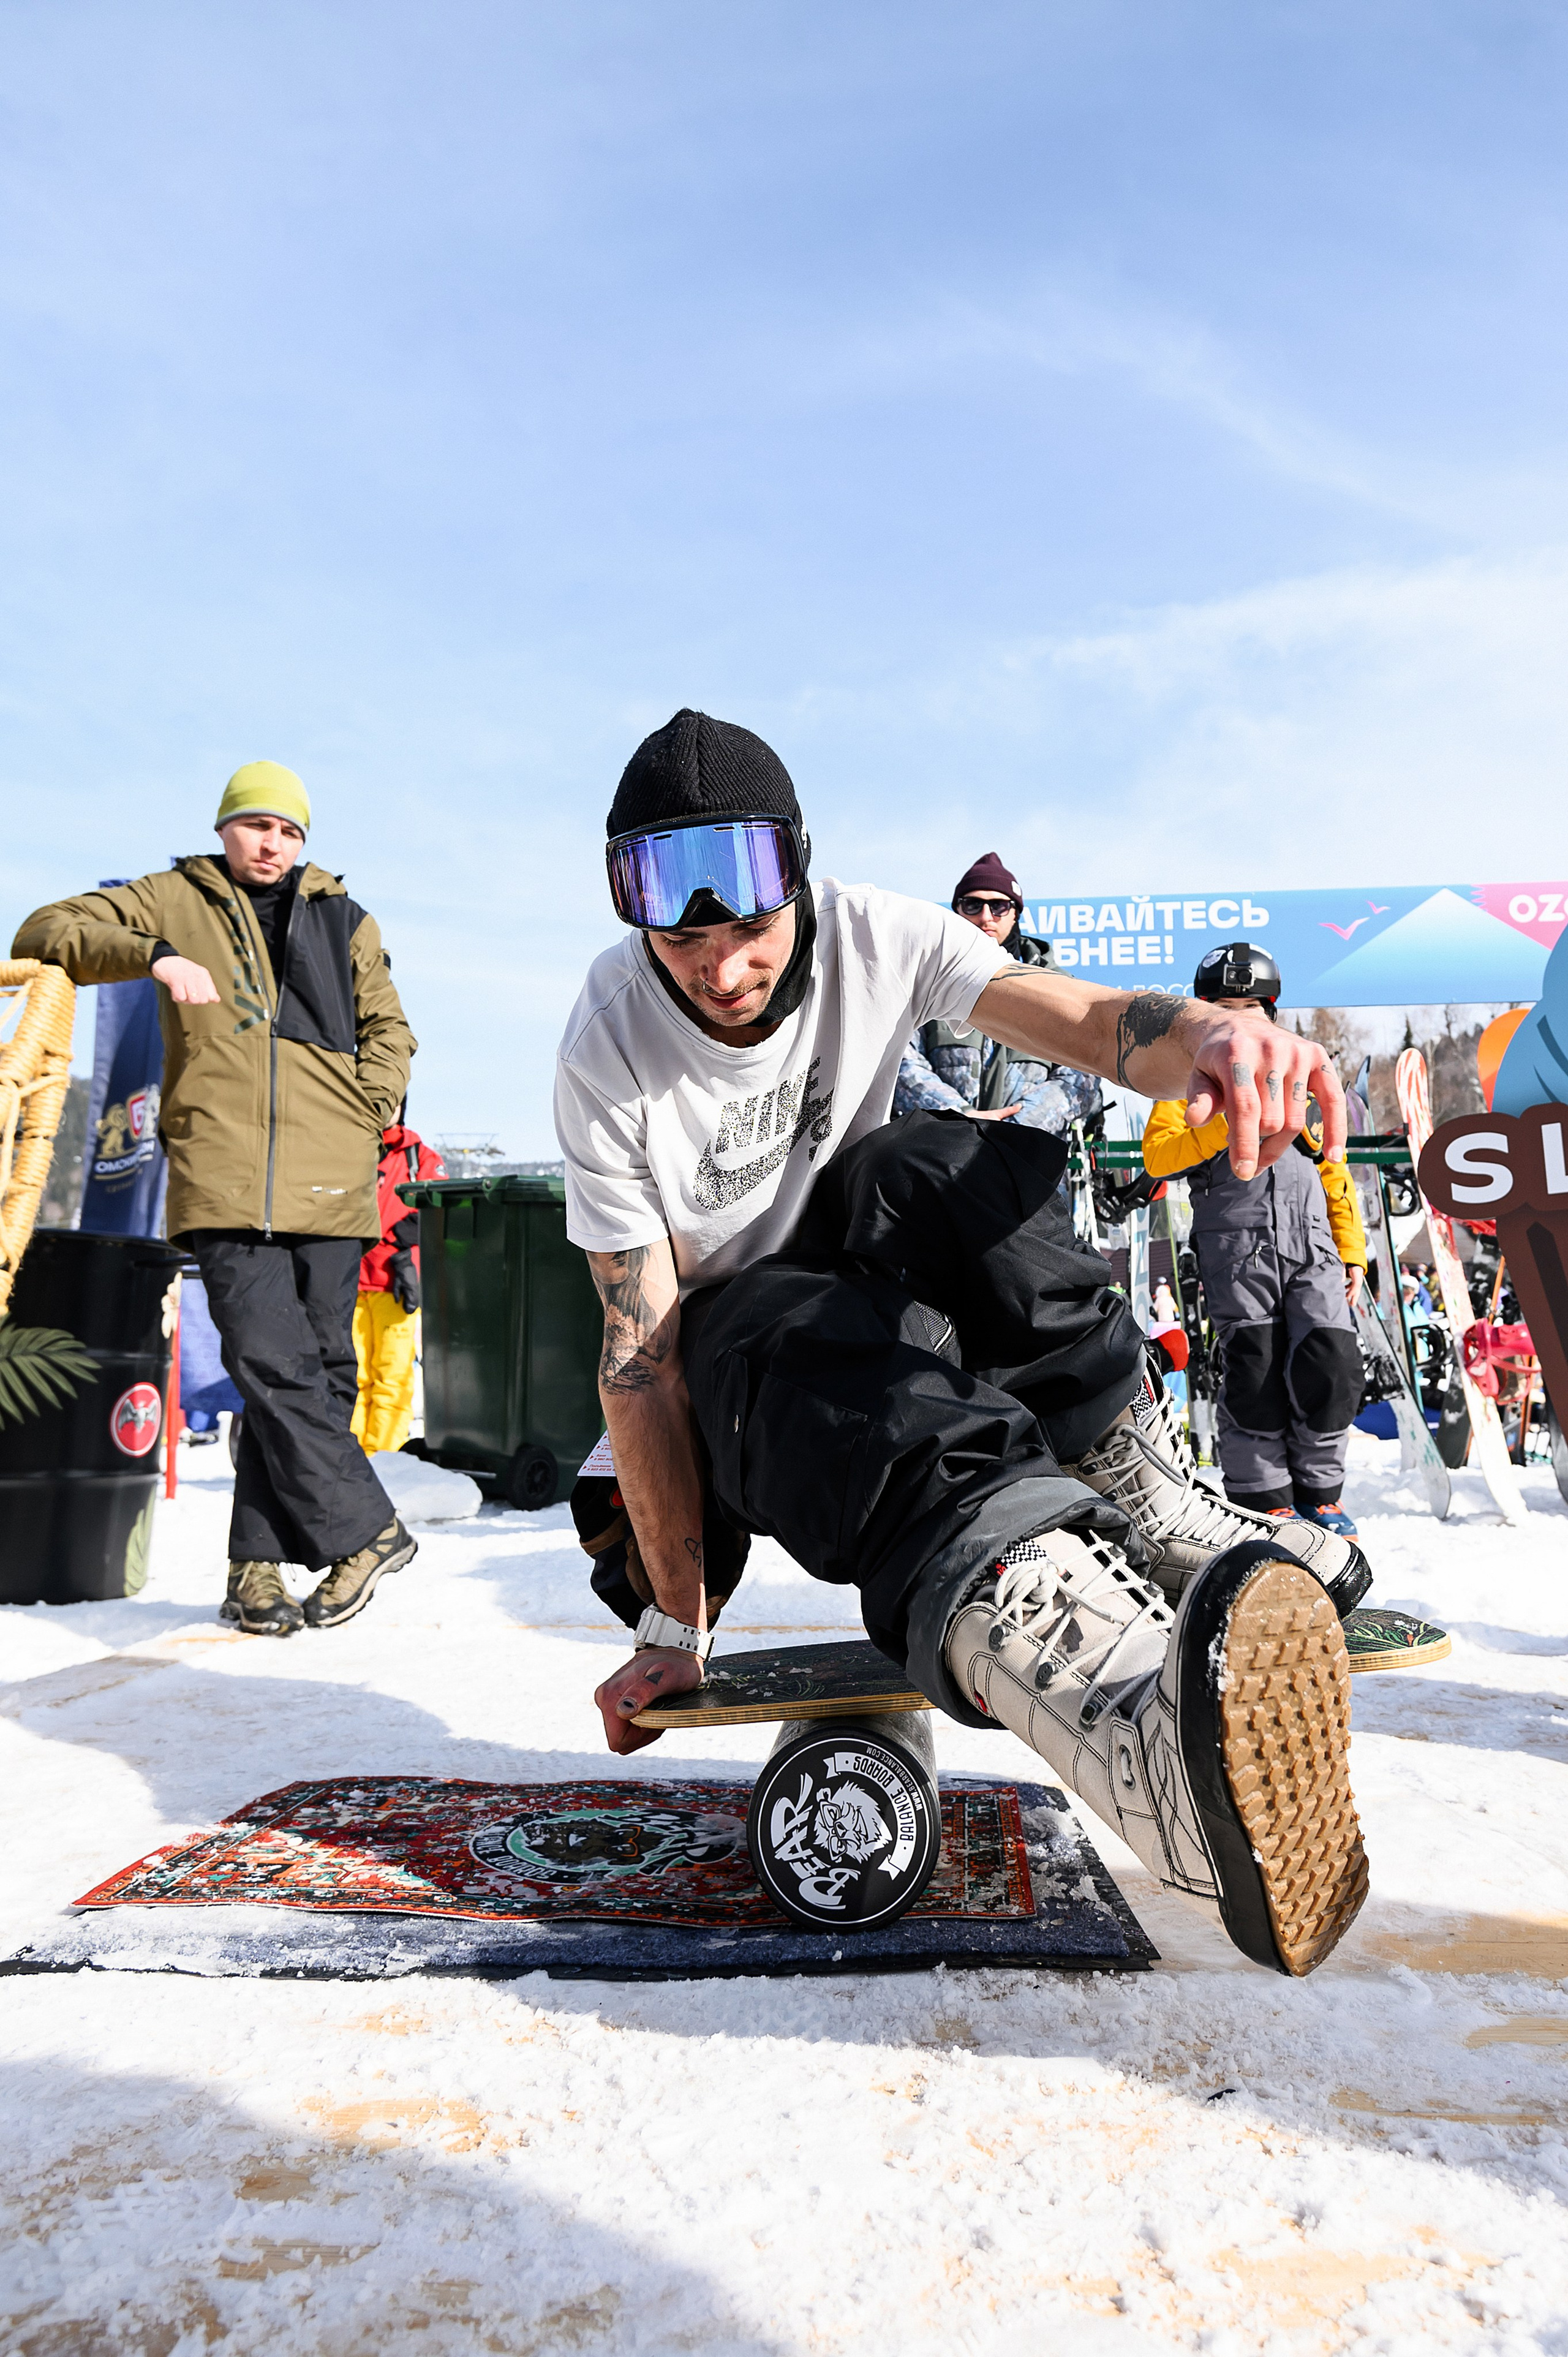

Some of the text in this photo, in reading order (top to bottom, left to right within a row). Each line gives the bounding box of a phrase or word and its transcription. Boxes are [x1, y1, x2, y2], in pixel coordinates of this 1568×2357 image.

[1509, 894, 1568, 924] OZ
[715, 1056, 821, 1153] NIKE
[853, 1755, 917, 1841] BALANCE BOARDS
[866, 1746, 923, 1811] WWW.BEARBALANCE.COM
[486, 1855, 557, 1879] BOARDS
[771, 1773, 861, 1909] BEAR
